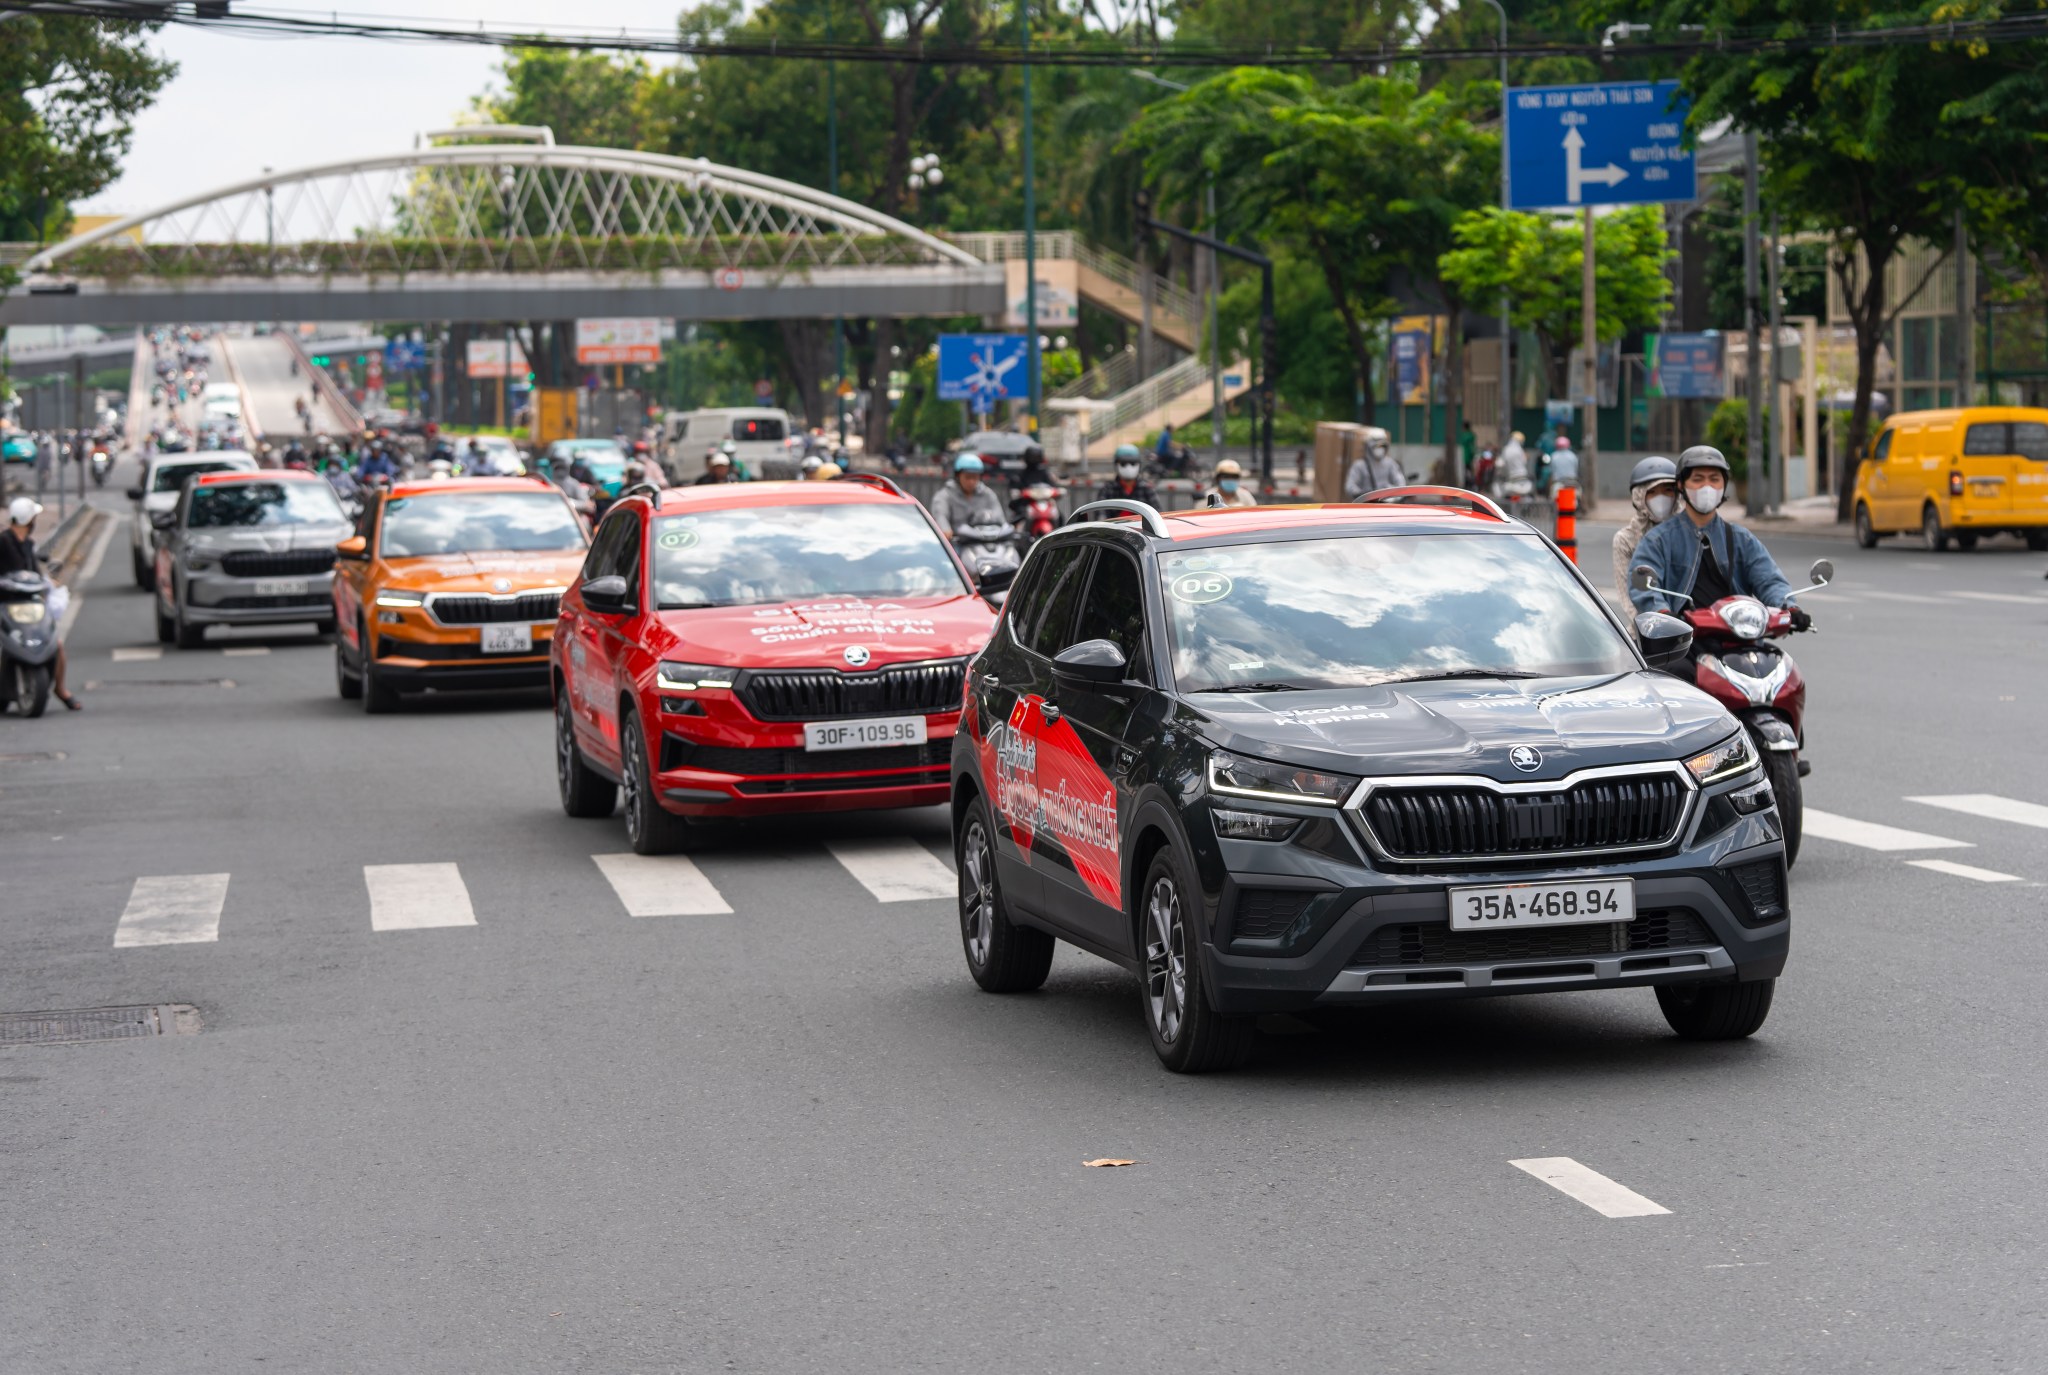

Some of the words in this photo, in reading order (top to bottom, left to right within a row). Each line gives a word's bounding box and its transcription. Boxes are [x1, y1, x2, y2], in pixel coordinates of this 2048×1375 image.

[665, 533, 690, 545] 07
[1181, 578, 1222, 594] 06
[750, 622, 813, 636] Sống
[817, 618, 884, 627] khám
[889, 618, 934, 627] phá
[902, 623, 935, 634] Âu
[1274, 704, 1368, 717] Skoda
[1274, 711, 1390, 726] Kushaq
[816, 723, 915, 745] 30F-109.96
[1467, 888, 1619, 921] 35A-468.94
